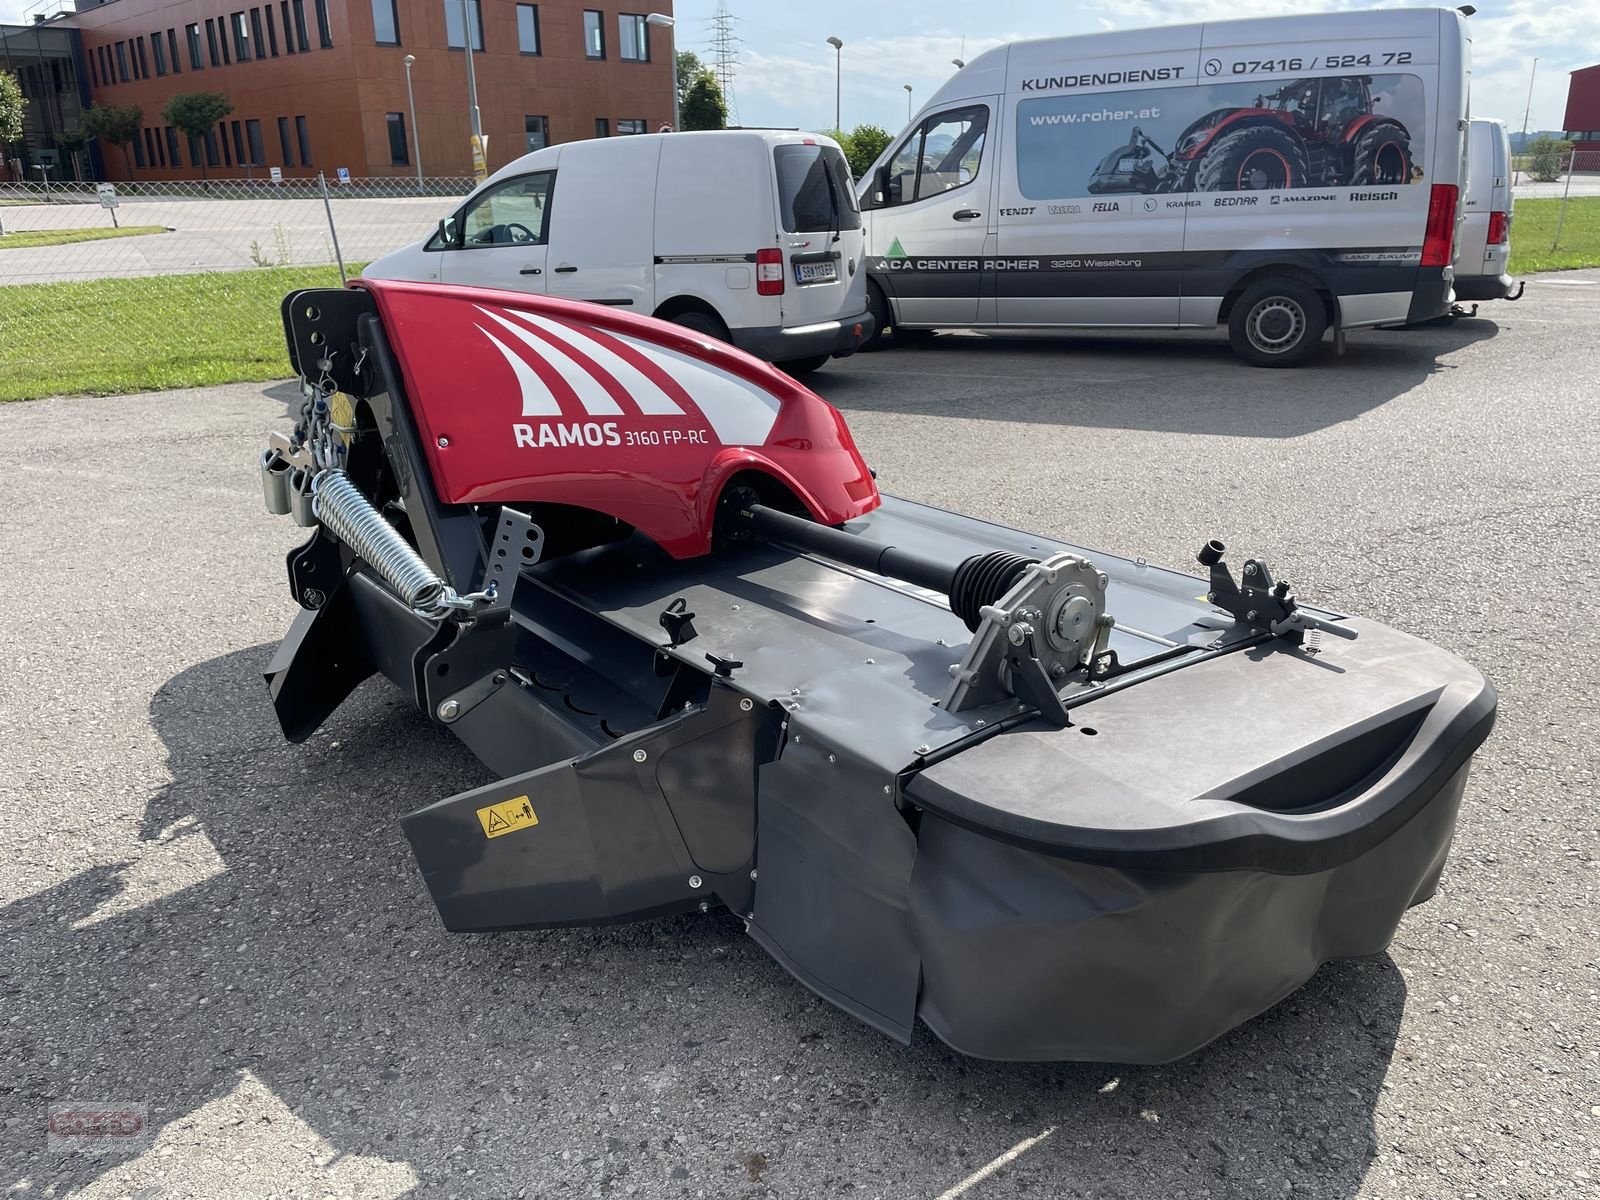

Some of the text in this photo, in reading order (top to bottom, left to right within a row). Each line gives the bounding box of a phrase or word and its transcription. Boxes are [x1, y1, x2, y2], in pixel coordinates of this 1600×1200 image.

[1022, 52, 1412, 91] KUNDENDIENST 07416 / 524 72
[1030, 106, 1160, 126] www.roher.at
[1000, 206, 1037, 216] FENDT
[1048, 204, 1081, 215] VALTRA
[1092, 202, 1120, 212] FELLA
[1166, 200, 1201, 209] KRAMER
[1214, 196, 1259, 207] BEDNAR
[1282, 195, 1337, 203] AMAZONE
[916, 260, 978, 270] CENTER
[983, 260, 1040, 270] ROHER
[1051, 260, 1081, 268] 3250
[1083, 258, 1142, 268] Wieselburg
[512, 422, 709, 448] RAMOS 3160 FP-RC
